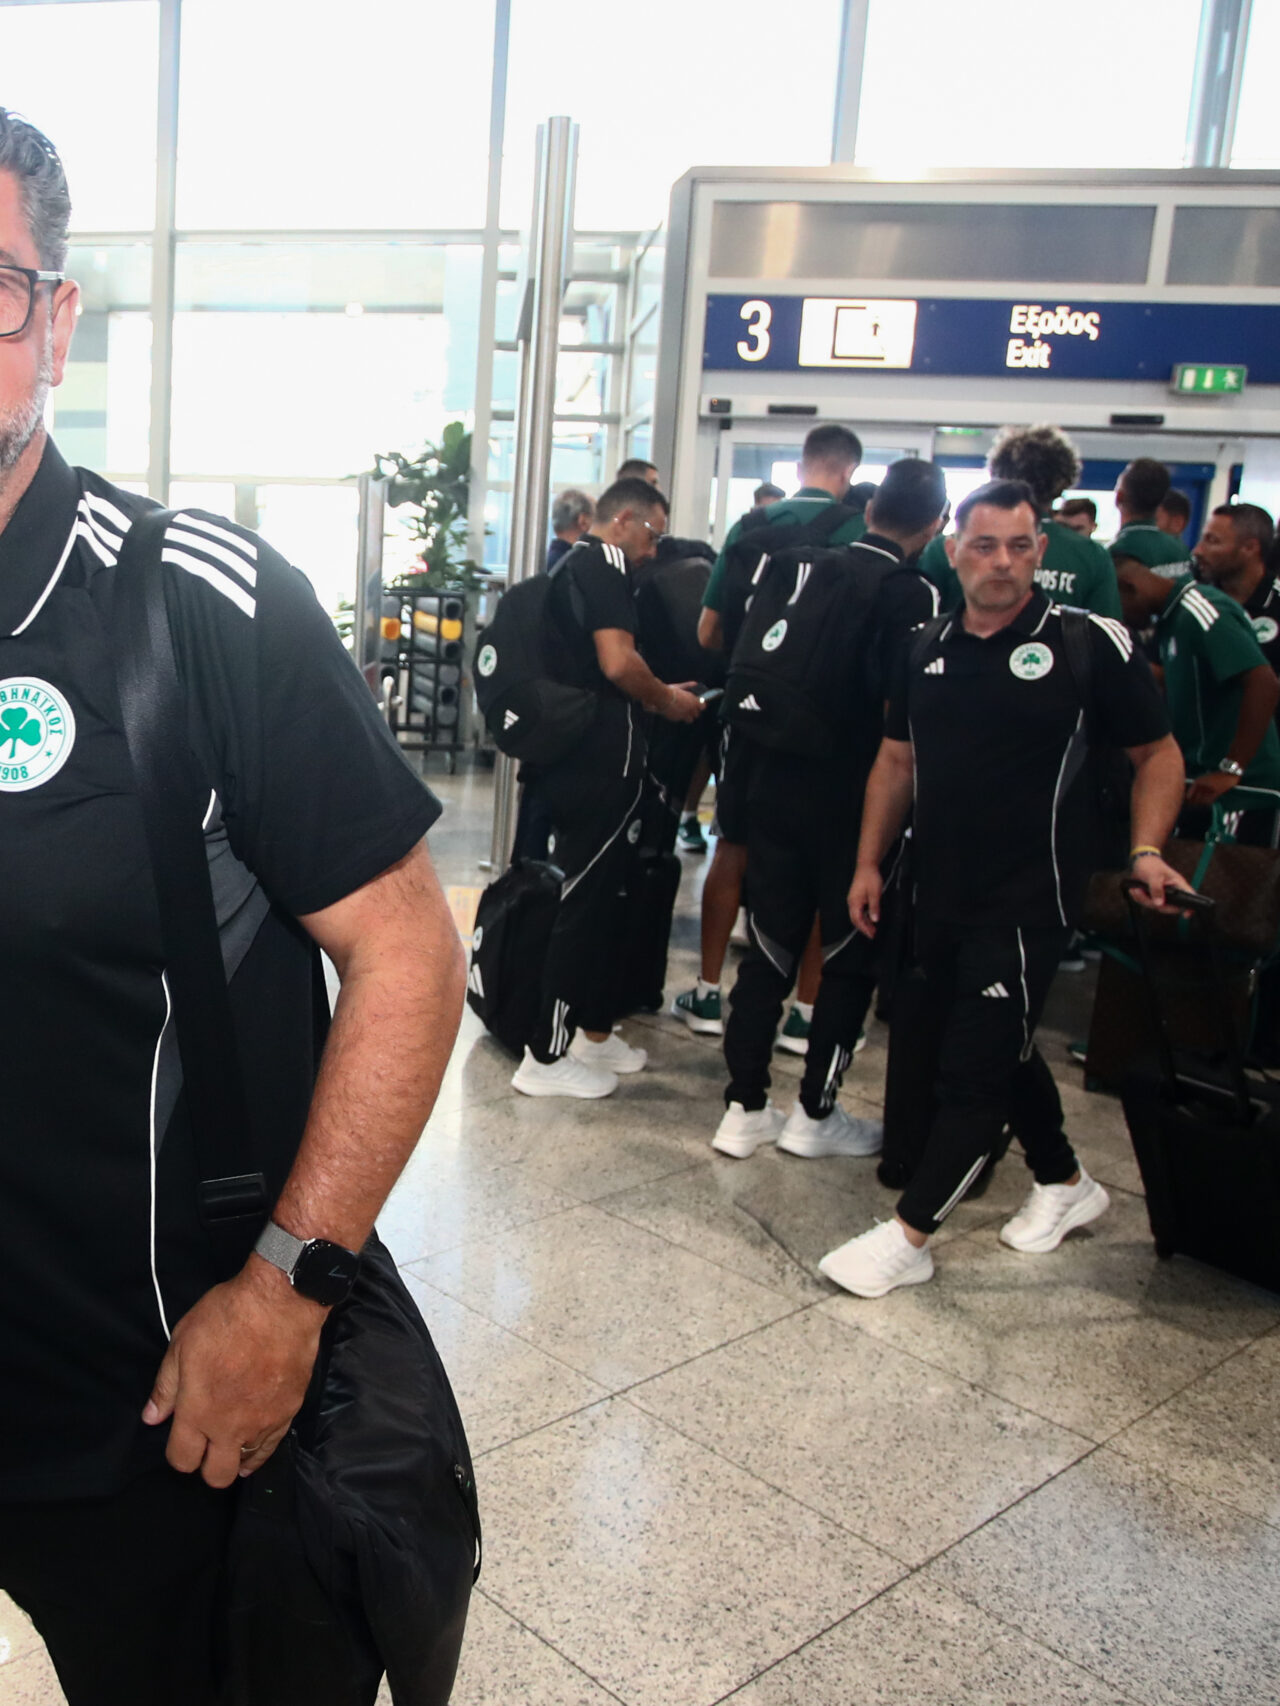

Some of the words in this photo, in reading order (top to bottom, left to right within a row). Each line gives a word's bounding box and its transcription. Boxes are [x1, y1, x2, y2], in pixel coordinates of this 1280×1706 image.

[737, 299, 772, 362] 3
[1006, 338, 1052, 369] Exit
[1059, 571, 1076, 594] FC
